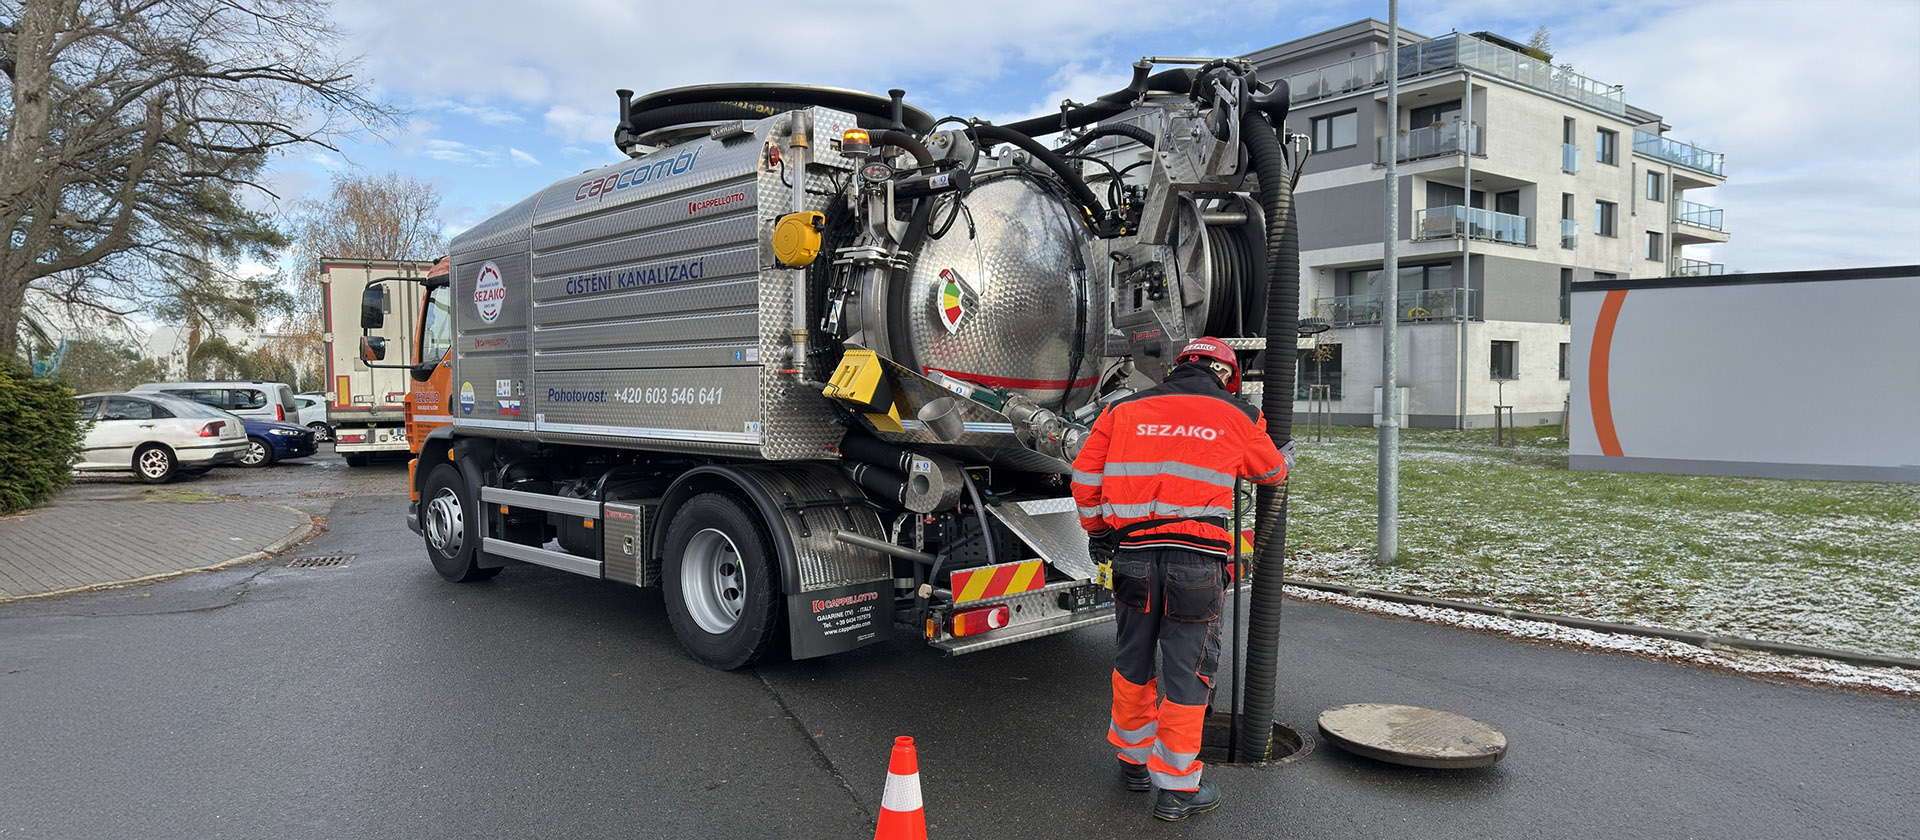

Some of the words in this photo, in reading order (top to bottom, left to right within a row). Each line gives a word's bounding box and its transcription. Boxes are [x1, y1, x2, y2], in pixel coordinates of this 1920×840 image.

[697, 192, 745, 210] CAPPELLOTTO
[566, 271, 612, 295] ČIŠTĚNÍ
[618, 257, 704, 289] KANALIZACÍ
[474, 288, 505, 303] SEZAKO
[548, 388, 607, 403] Pohotovost:
[614, 387, 641, 404] +420
[645, 387, 667, 404] 603
[671, 387, 695, 404] 546
[699, 386, 723, 405] 641
[824, 592, 878, 608] CAPPELLOTTO
[817, 612, 844, 621] GAIARINE
[844, 609, 854, 617] (TV)
[824, 621, 871, 635] www.cappellotto.com
